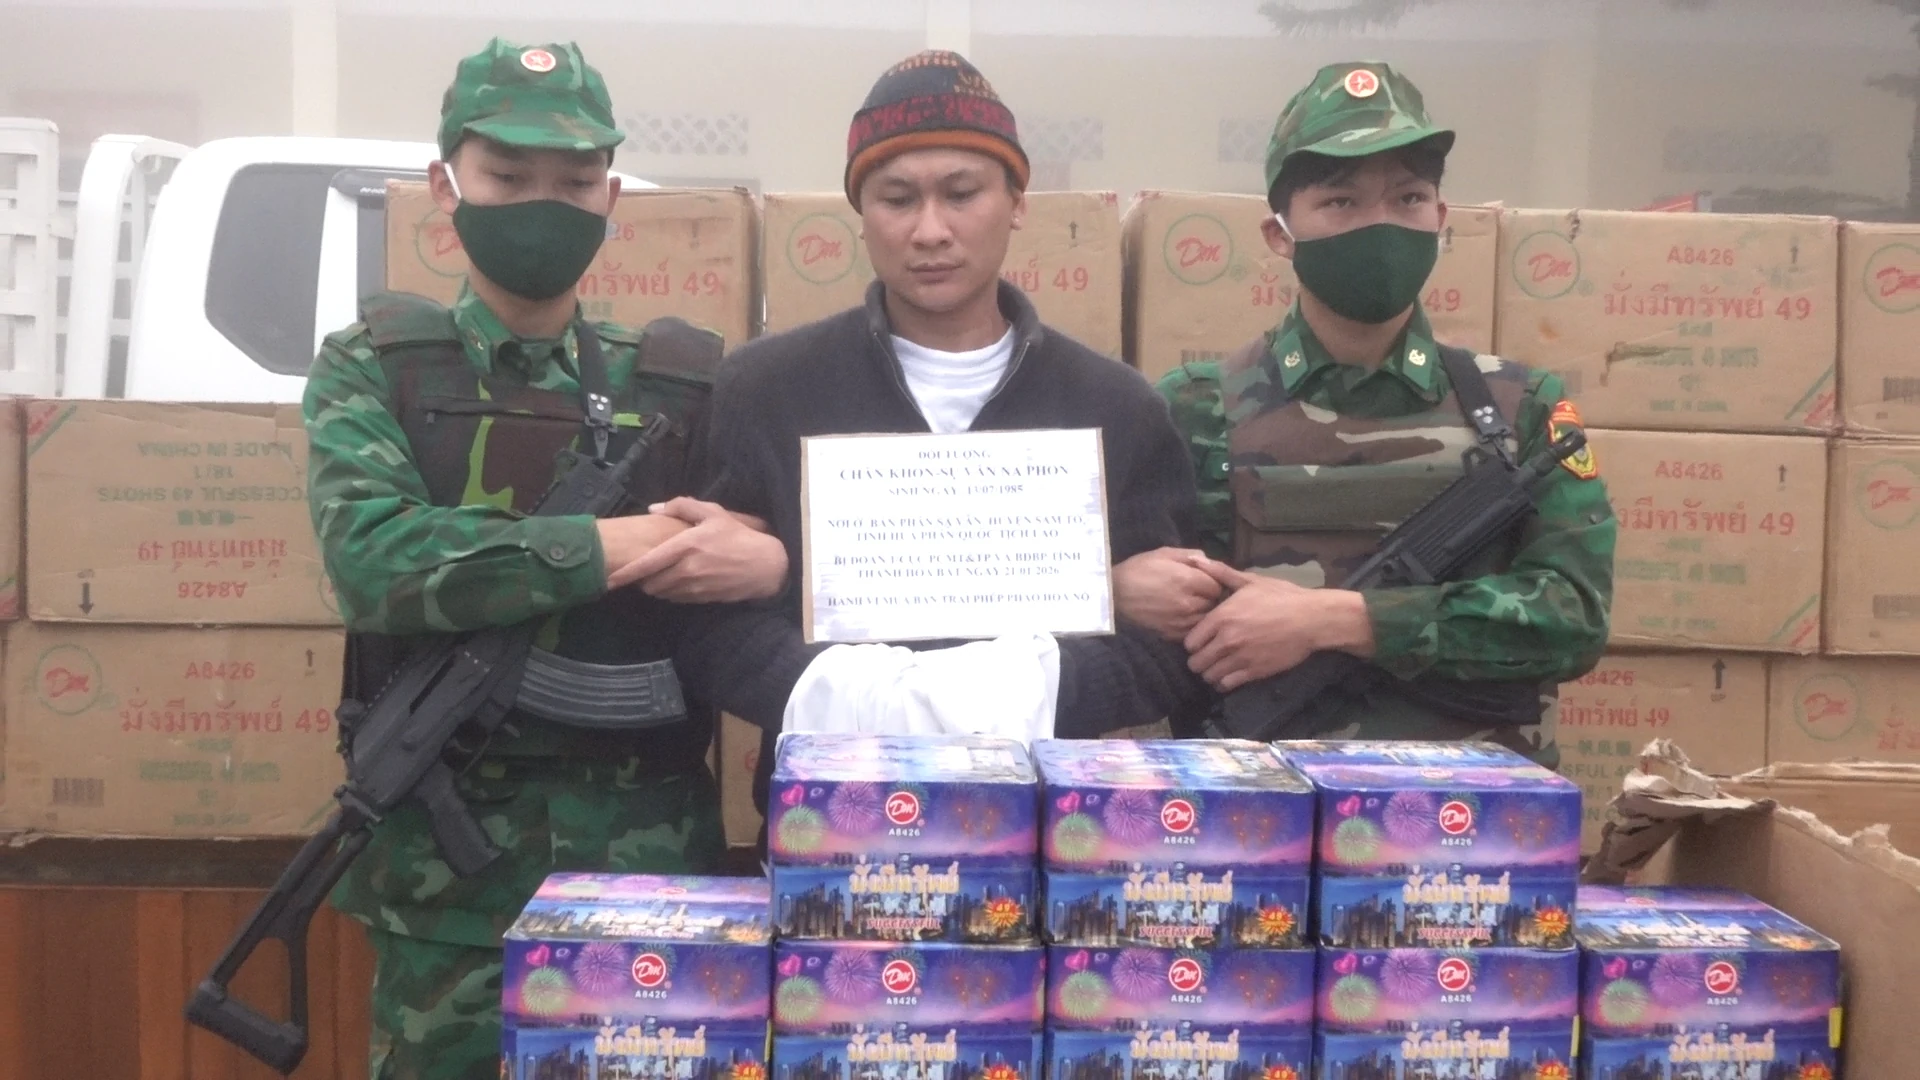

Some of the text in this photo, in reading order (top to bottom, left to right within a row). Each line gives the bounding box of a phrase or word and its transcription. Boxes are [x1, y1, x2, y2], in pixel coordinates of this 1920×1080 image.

[1667, 246, 1734, 266] A8426
[683, 274, 721, 297] 49
[1053, 266, 1089, 293] 49
[1425, 288, 1461, 313] 49
[1776, 296, 1812, 321] 49
[1655, 460, 1724, 482] A8426
[1759, 512, 1796, 536] 49
[137, 541, 164, 561] 49
[178, 581, 248, 599] A8426
[184, 660, 257, 681] A8426
[294, 708, 332, 734] 49
[1645, 707, 1671, 728] 49
